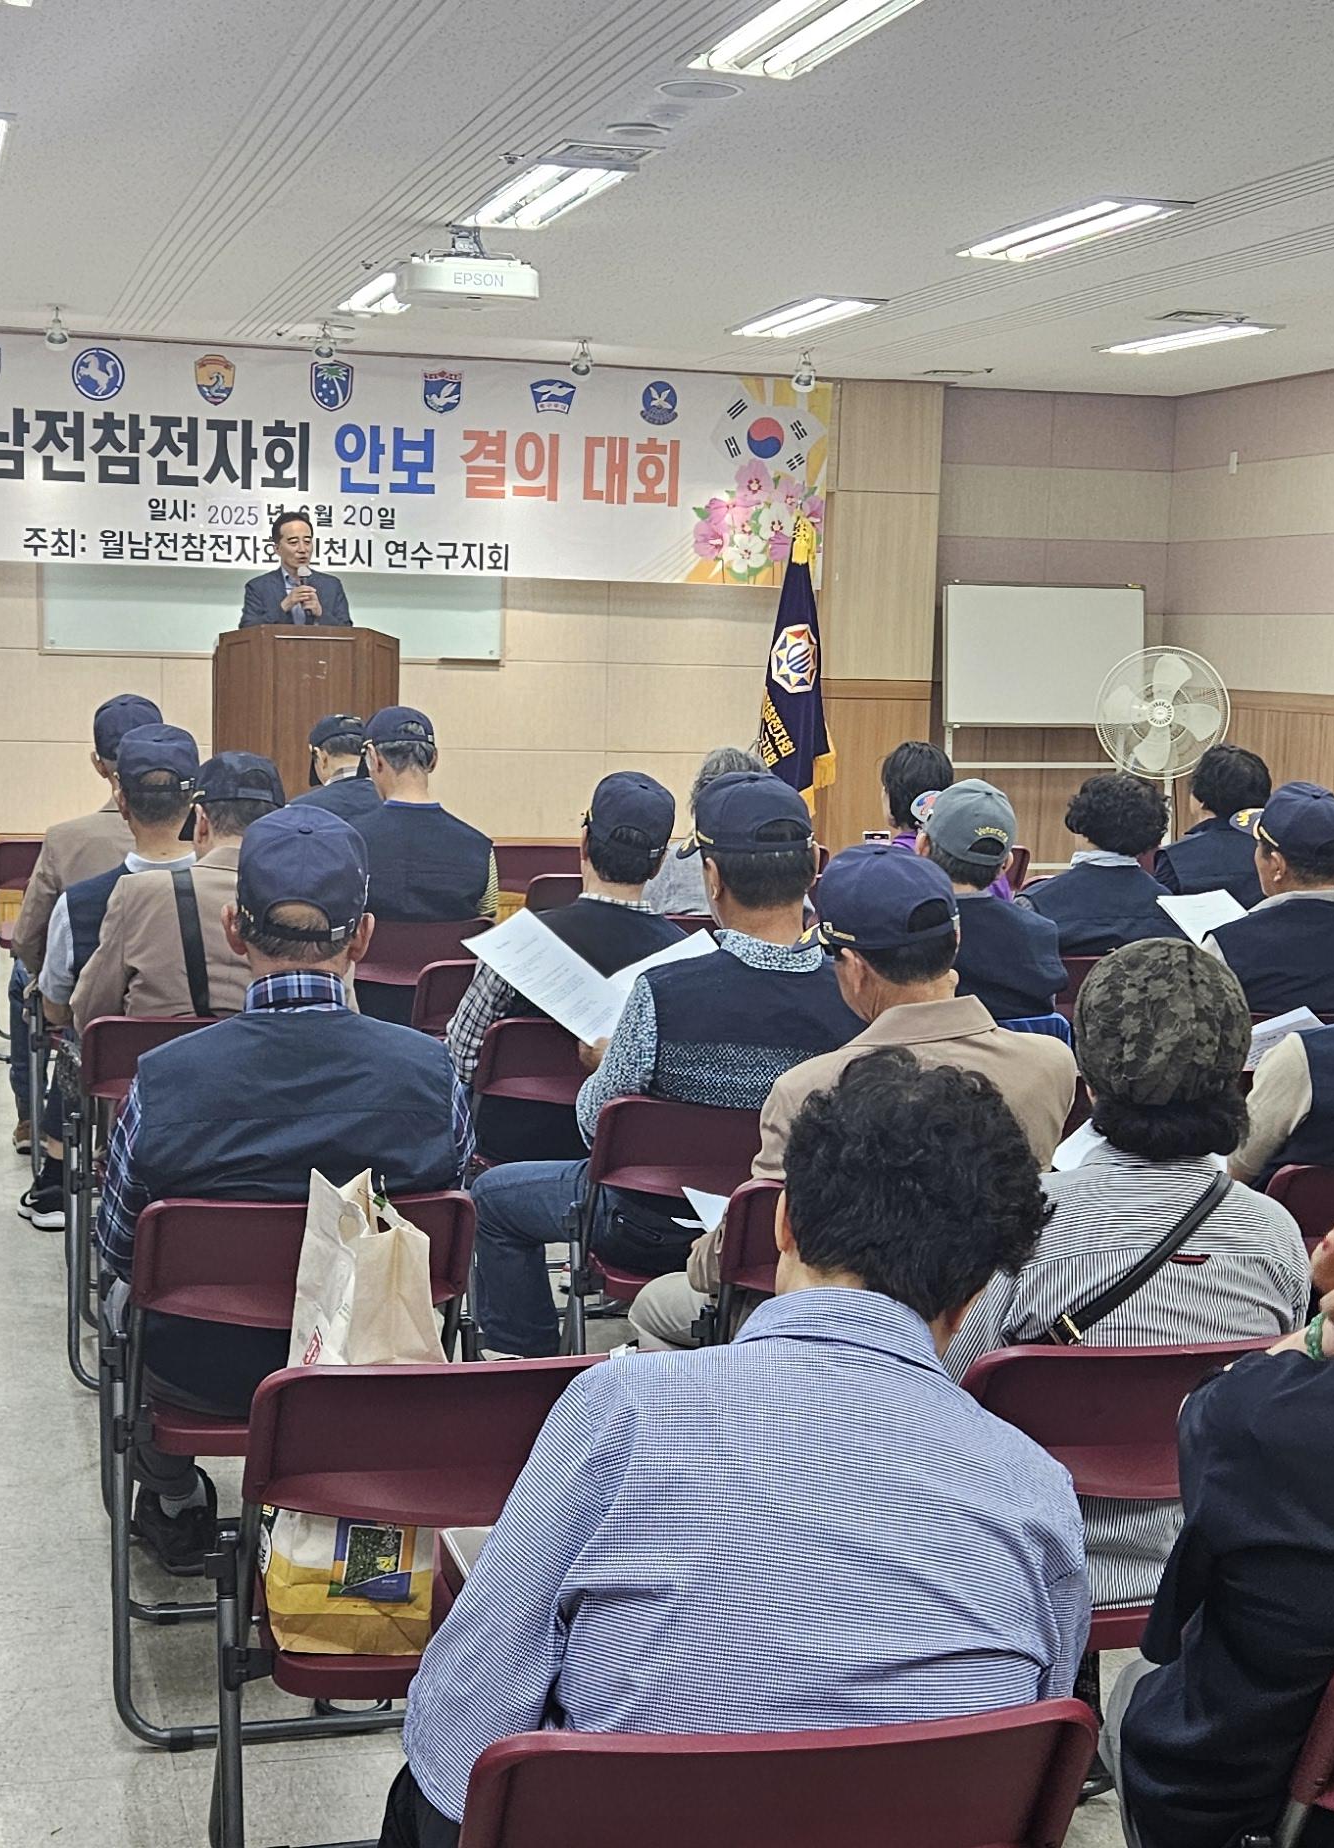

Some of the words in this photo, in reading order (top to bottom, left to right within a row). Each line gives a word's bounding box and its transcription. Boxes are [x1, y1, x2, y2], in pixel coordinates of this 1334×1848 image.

[453, 271, 504, 287] EPSON
[335, 424, 435, 494] 안보
[459, 430, 559, 502] 결의
[584, 437, 680, 507] 대회
[148, 498, 196, 522] 일시:
[207, 504, 259, 526] 2025
[23, 527, 86, 558] 주최:
[385, 540, 509, 571] 연수구지회
